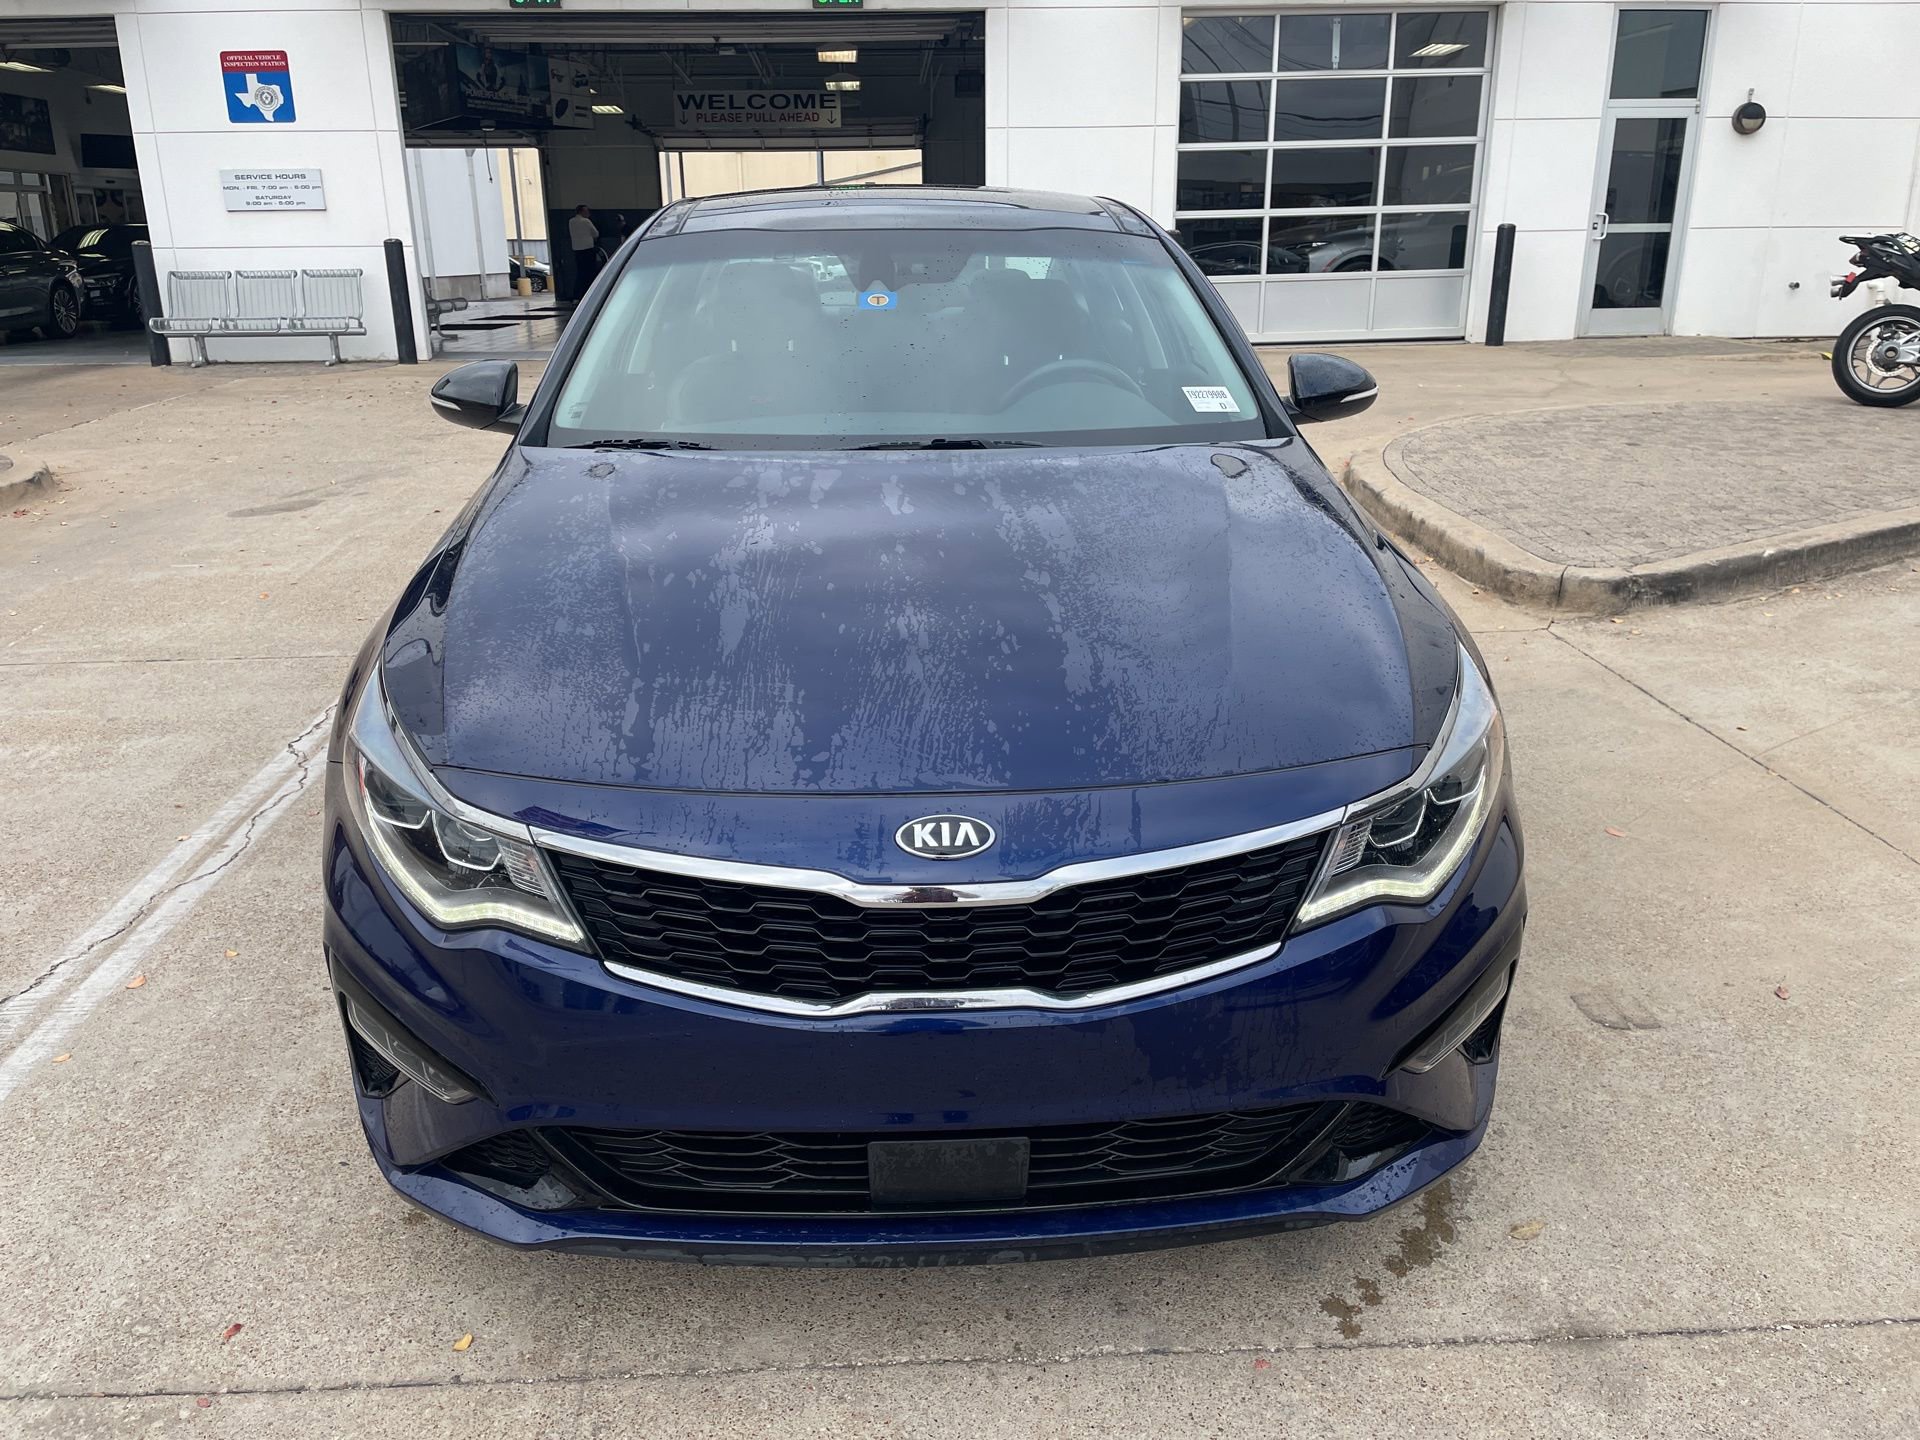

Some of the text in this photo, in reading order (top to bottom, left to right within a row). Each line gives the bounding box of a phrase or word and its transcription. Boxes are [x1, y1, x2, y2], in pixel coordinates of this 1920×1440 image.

[676, 93, 838, 110] WELCOME
[696, 111, 820, 123] PLEASE PULL AHEAD
[912, 822, 980, 848] KIA
